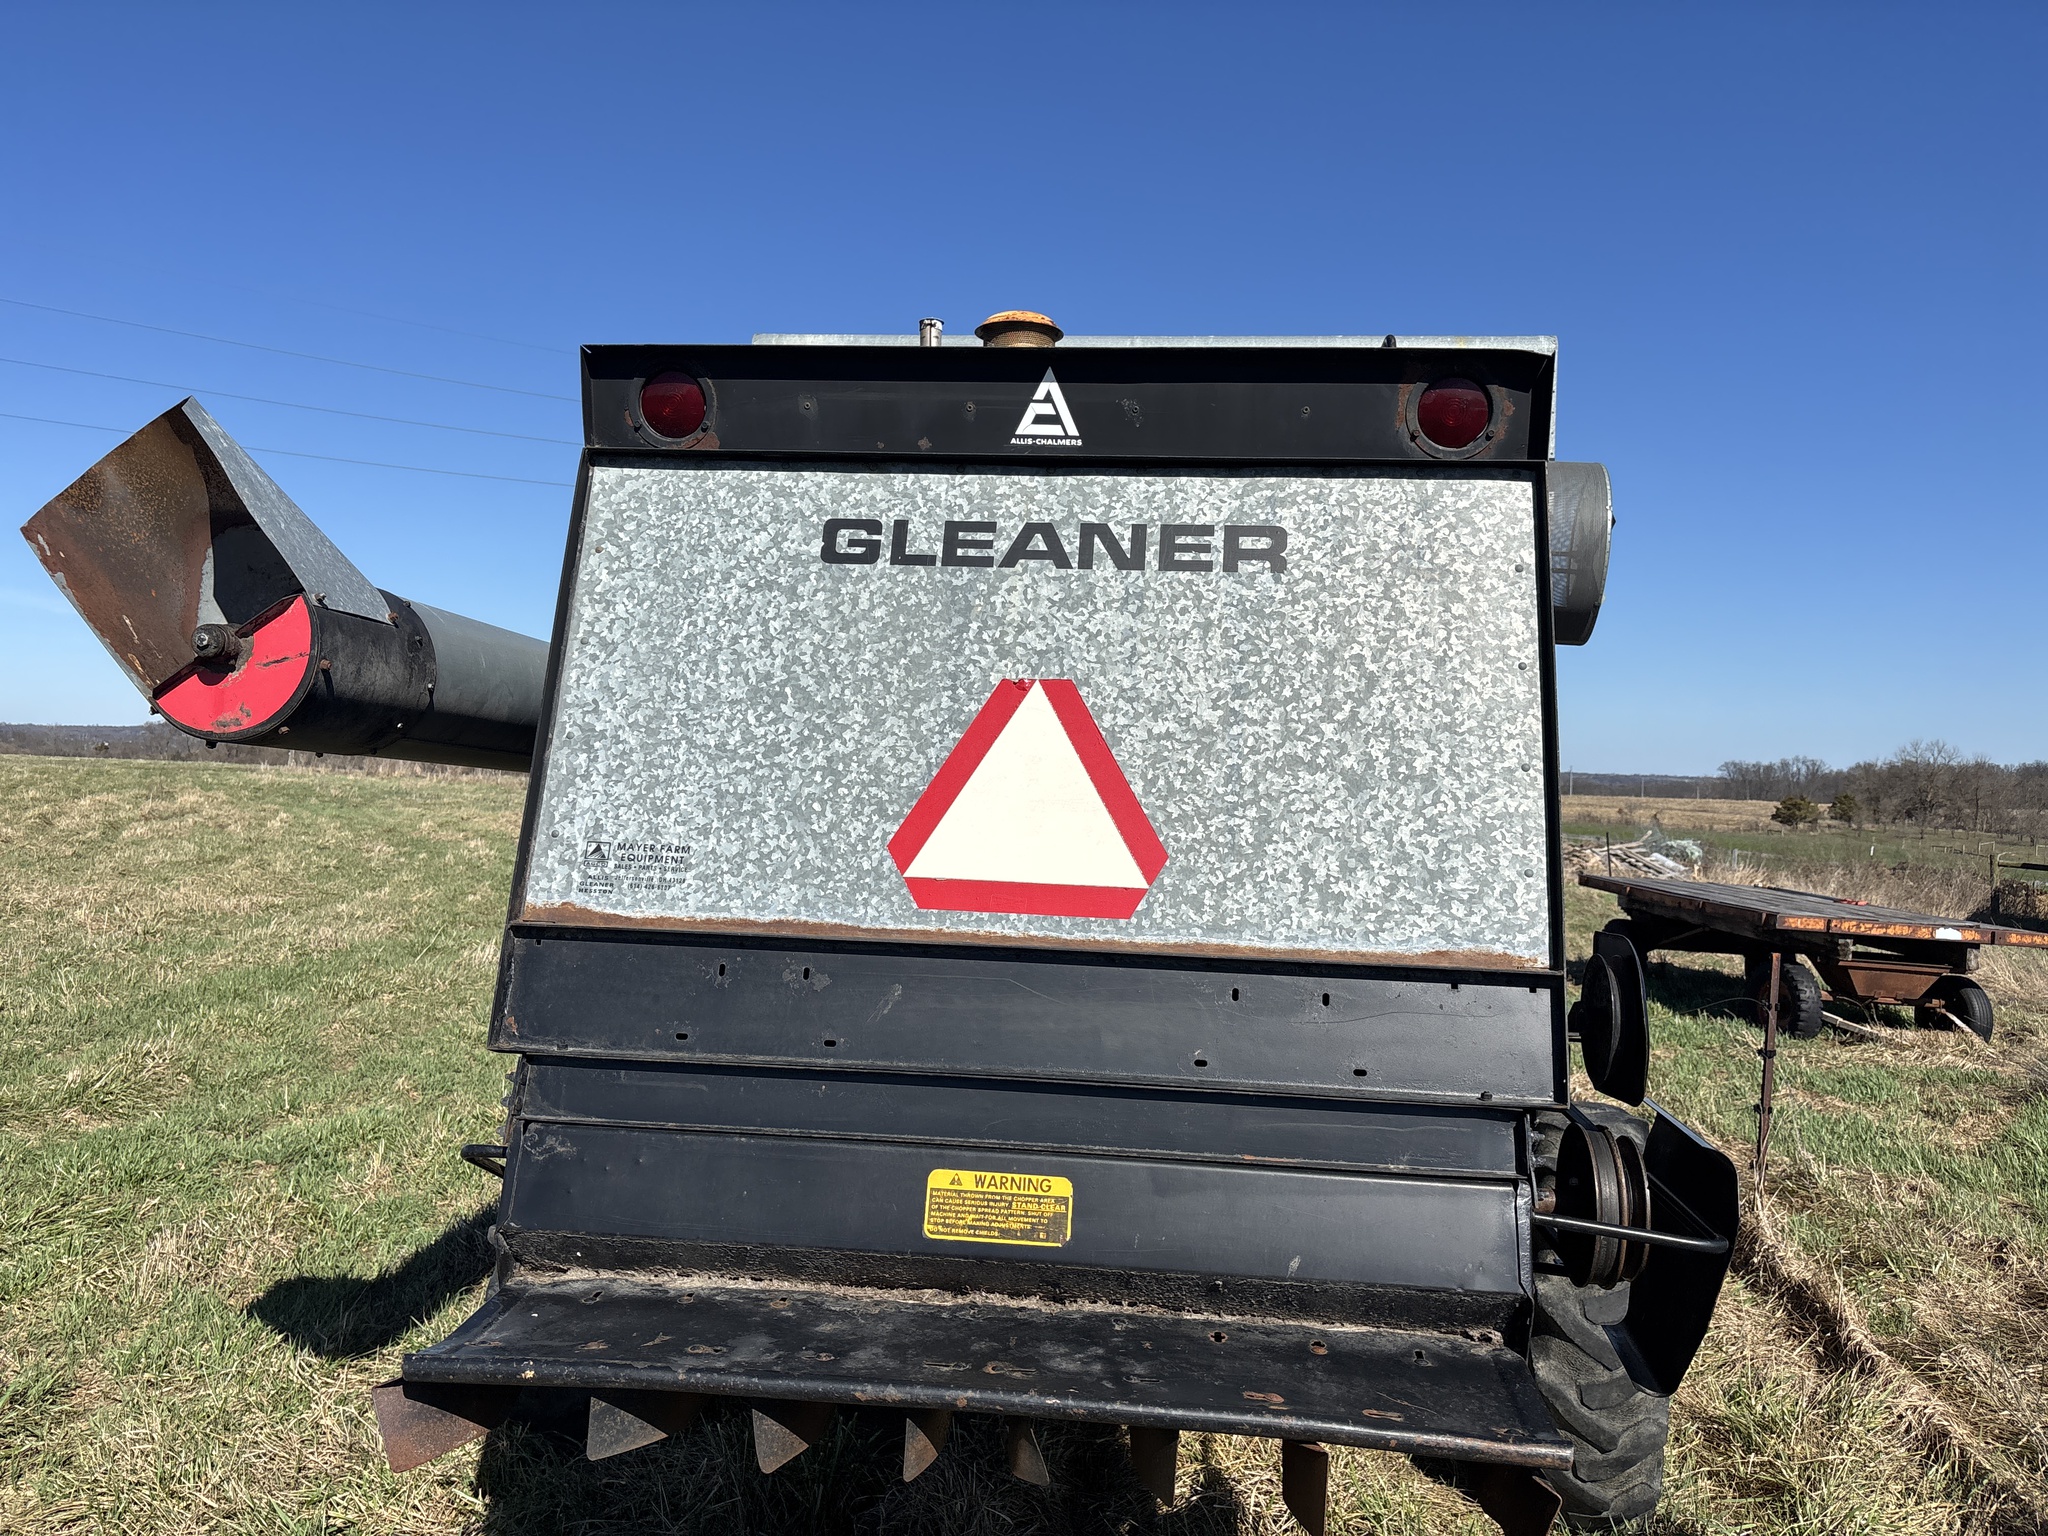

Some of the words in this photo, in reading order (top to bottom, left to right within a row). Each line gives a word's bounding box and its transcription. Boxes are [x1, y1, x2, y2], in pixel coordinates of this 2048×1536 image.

[1010, 437, 1083, 446] ALLIS-CHALMERS
[820, 518, 1288, 573] GLEANER
[616, 842, 656, 853] MAYER
[660, 844, 691, 854] FARM
[620, 853, 685, 865] EQUIPMENT
[663, 865, 688, 873] SERVICE
[974, 1173, 1052, 1193] WARNING
[932, 1190, 958, 1198] MATERIAL
[1007, 1216, 1039, 1224] MOVEMENT
